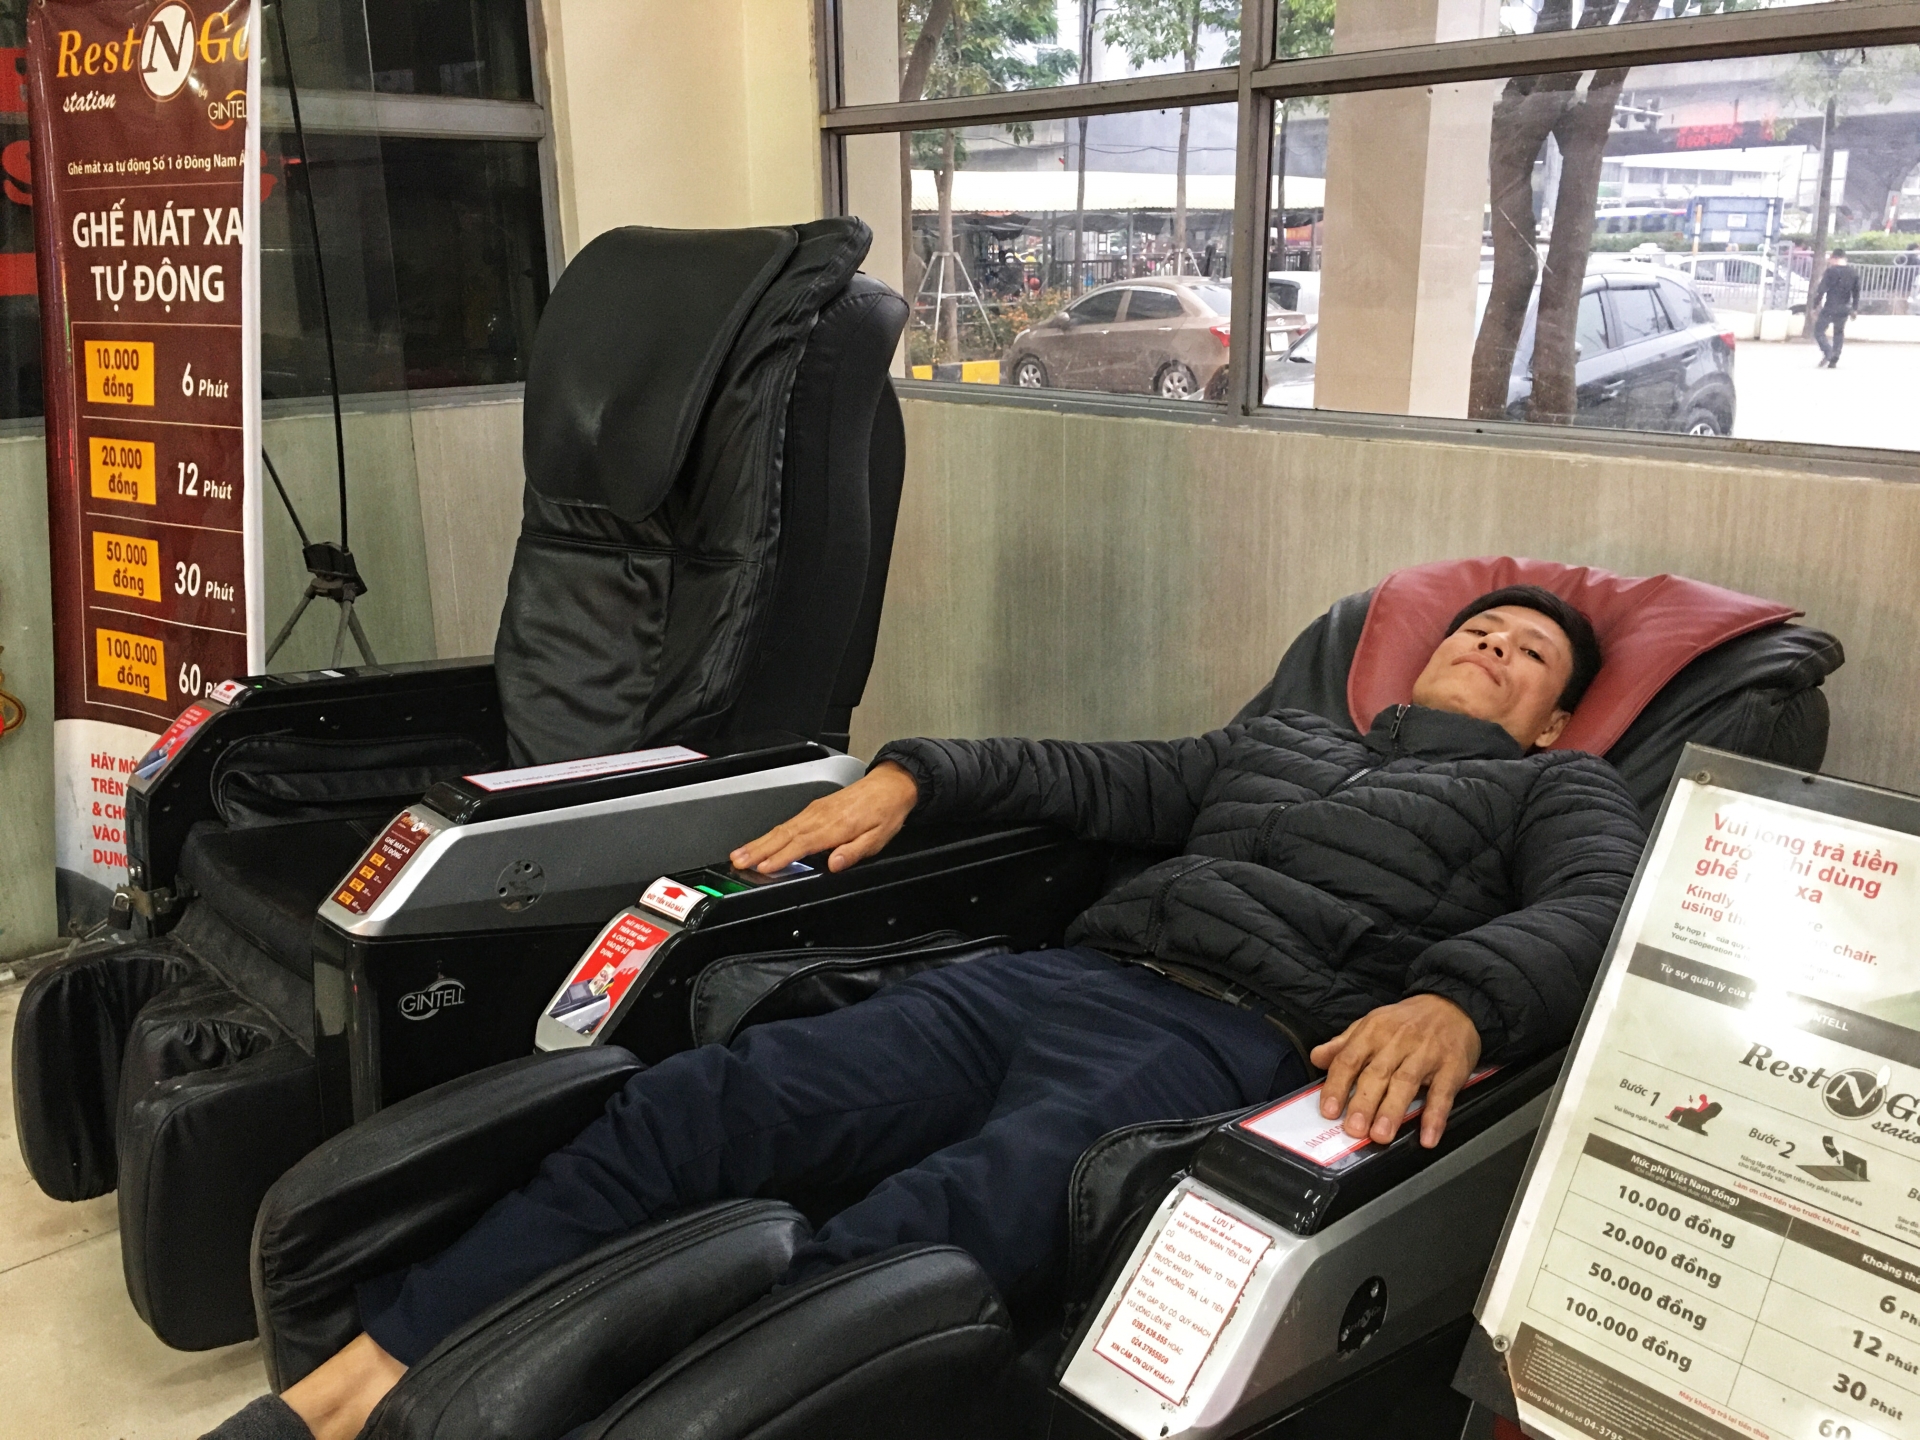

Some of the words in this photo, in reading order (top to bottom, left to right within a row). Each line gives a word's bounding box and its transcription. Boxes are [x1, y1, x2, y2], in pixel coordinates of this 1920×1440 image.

[57, 28, 141, 77] Rest
[142, 14, 192, 73] N
[62, 90, 116, 112] station
[67, 159, 82, 175] Ghế
[84, 160, 101, 173] mát
[102, 162, 113, 172] xa
[115, 160, 125, 175] tự
[127, 157, 150, 174] động
[152, 154, 165, 170] Số
[167, 156, 172, 169] 1
[175, 154, 182, 169] ở
[183, 154, 211, 171] Đông
[213, 153, 236, 167] Nam
[72, 198, 125, 248] GHẾ
[132, 200, 195, 246] MÁT
[203, 206, 244, 246] XA
[90, 259, 127, 311] TỰ
[132, 257, 224, 312] ĐỘNG
[96, 348, 139, 370] 10.000
[103, 376, 134, 402] đồng
[181, 363, 193, 396] 6
[198, 378, 228, 397] Phút
[101, 445, 142, 469] 20.000
[108, 473, 138, 500] đồng
[178, 461, 198, 496] 12
[203, 480, 232, 499] Phút
[106, 540, 147, 566] 50.000
[113, 568, 144, 596] đồng
[174, 561, 200, 596] 30
[205, 580, 234, 601] Phút
[106, 636, 157, 666] 100.000
[117, 666, 150, 694] đồng
[178, 662, 201, 697] 60
[91, 752, 116, 771] HÃY
[91, 777, 124, 796] TRÊN
[92, 801, 102, 817] &
[92, 823, 120, 843] VÀO
[1704, 835, 1753, 860] trướ
[1789, 856, 1813, 876] hi
[1818, 865, 1882, 899] dùng
[1812, 839, 1845, 862] trả
[1852, 849, 1899, 876] tiền
[1686, 884, 1735, 909] Kindly
[1694, 859, 1740, 880] ghế
[1794, 885, 1823, 905] xa
[1681, 900, 1724, 922] using
[1833, 943, 1878, 967] chair.
[1660, 962, 1674, 974] Từ
[1675, 970, 1689, 980] sự
[1690, 975, 1715, 988] quản
[1716, 982, 1726, 992] lý
[1728, 986, 1746, 998] của
[401, 988, 465, 1013] GINTELL
[1619, 1078, 1648, 1096] Bước
[1650, 1092, 1661, 1106] 1
[1738, 1042, 1831, 1089] Rest
[1825, 1072, 1878, 1109] N
[1748, 1126, 1780, 1148] Bước
[1779, 1140, 1796, 1158] 2
[1630, 1154, 1649, 1168] Mức
[1670, 1170, 1687, 1184] Việt
[1688, 1178, 1710, 1193] Nam
[1711, 1188, 1739, 1206] đồng)
[1862, 1254, 1902, 1278] Khoảng
[1619, 1185, 1680, 1221] 10.000
[1684, 1214, 1735, 1249] đồng
[1880, 1295, 1897, 1314] 6
[1602, 1222, 1667, 1260] 20.000
[1670, 1253, 1721, 1288] đồng
[1852, 1330, 1882, 1358] 12
[1885, 1352, 1920, 1376] Phút
[1566, 1297, 1638, 1342] 100.000
[1641, 1336, 1692, 1372] đồng
[1588, 1262, 1652, 1301] 50.000
[1656, 1295, 1706, 1330] đồng
[1832, 1373, 1868, 1402] 30
[1870, 1397, 1904, 1421] Phút
